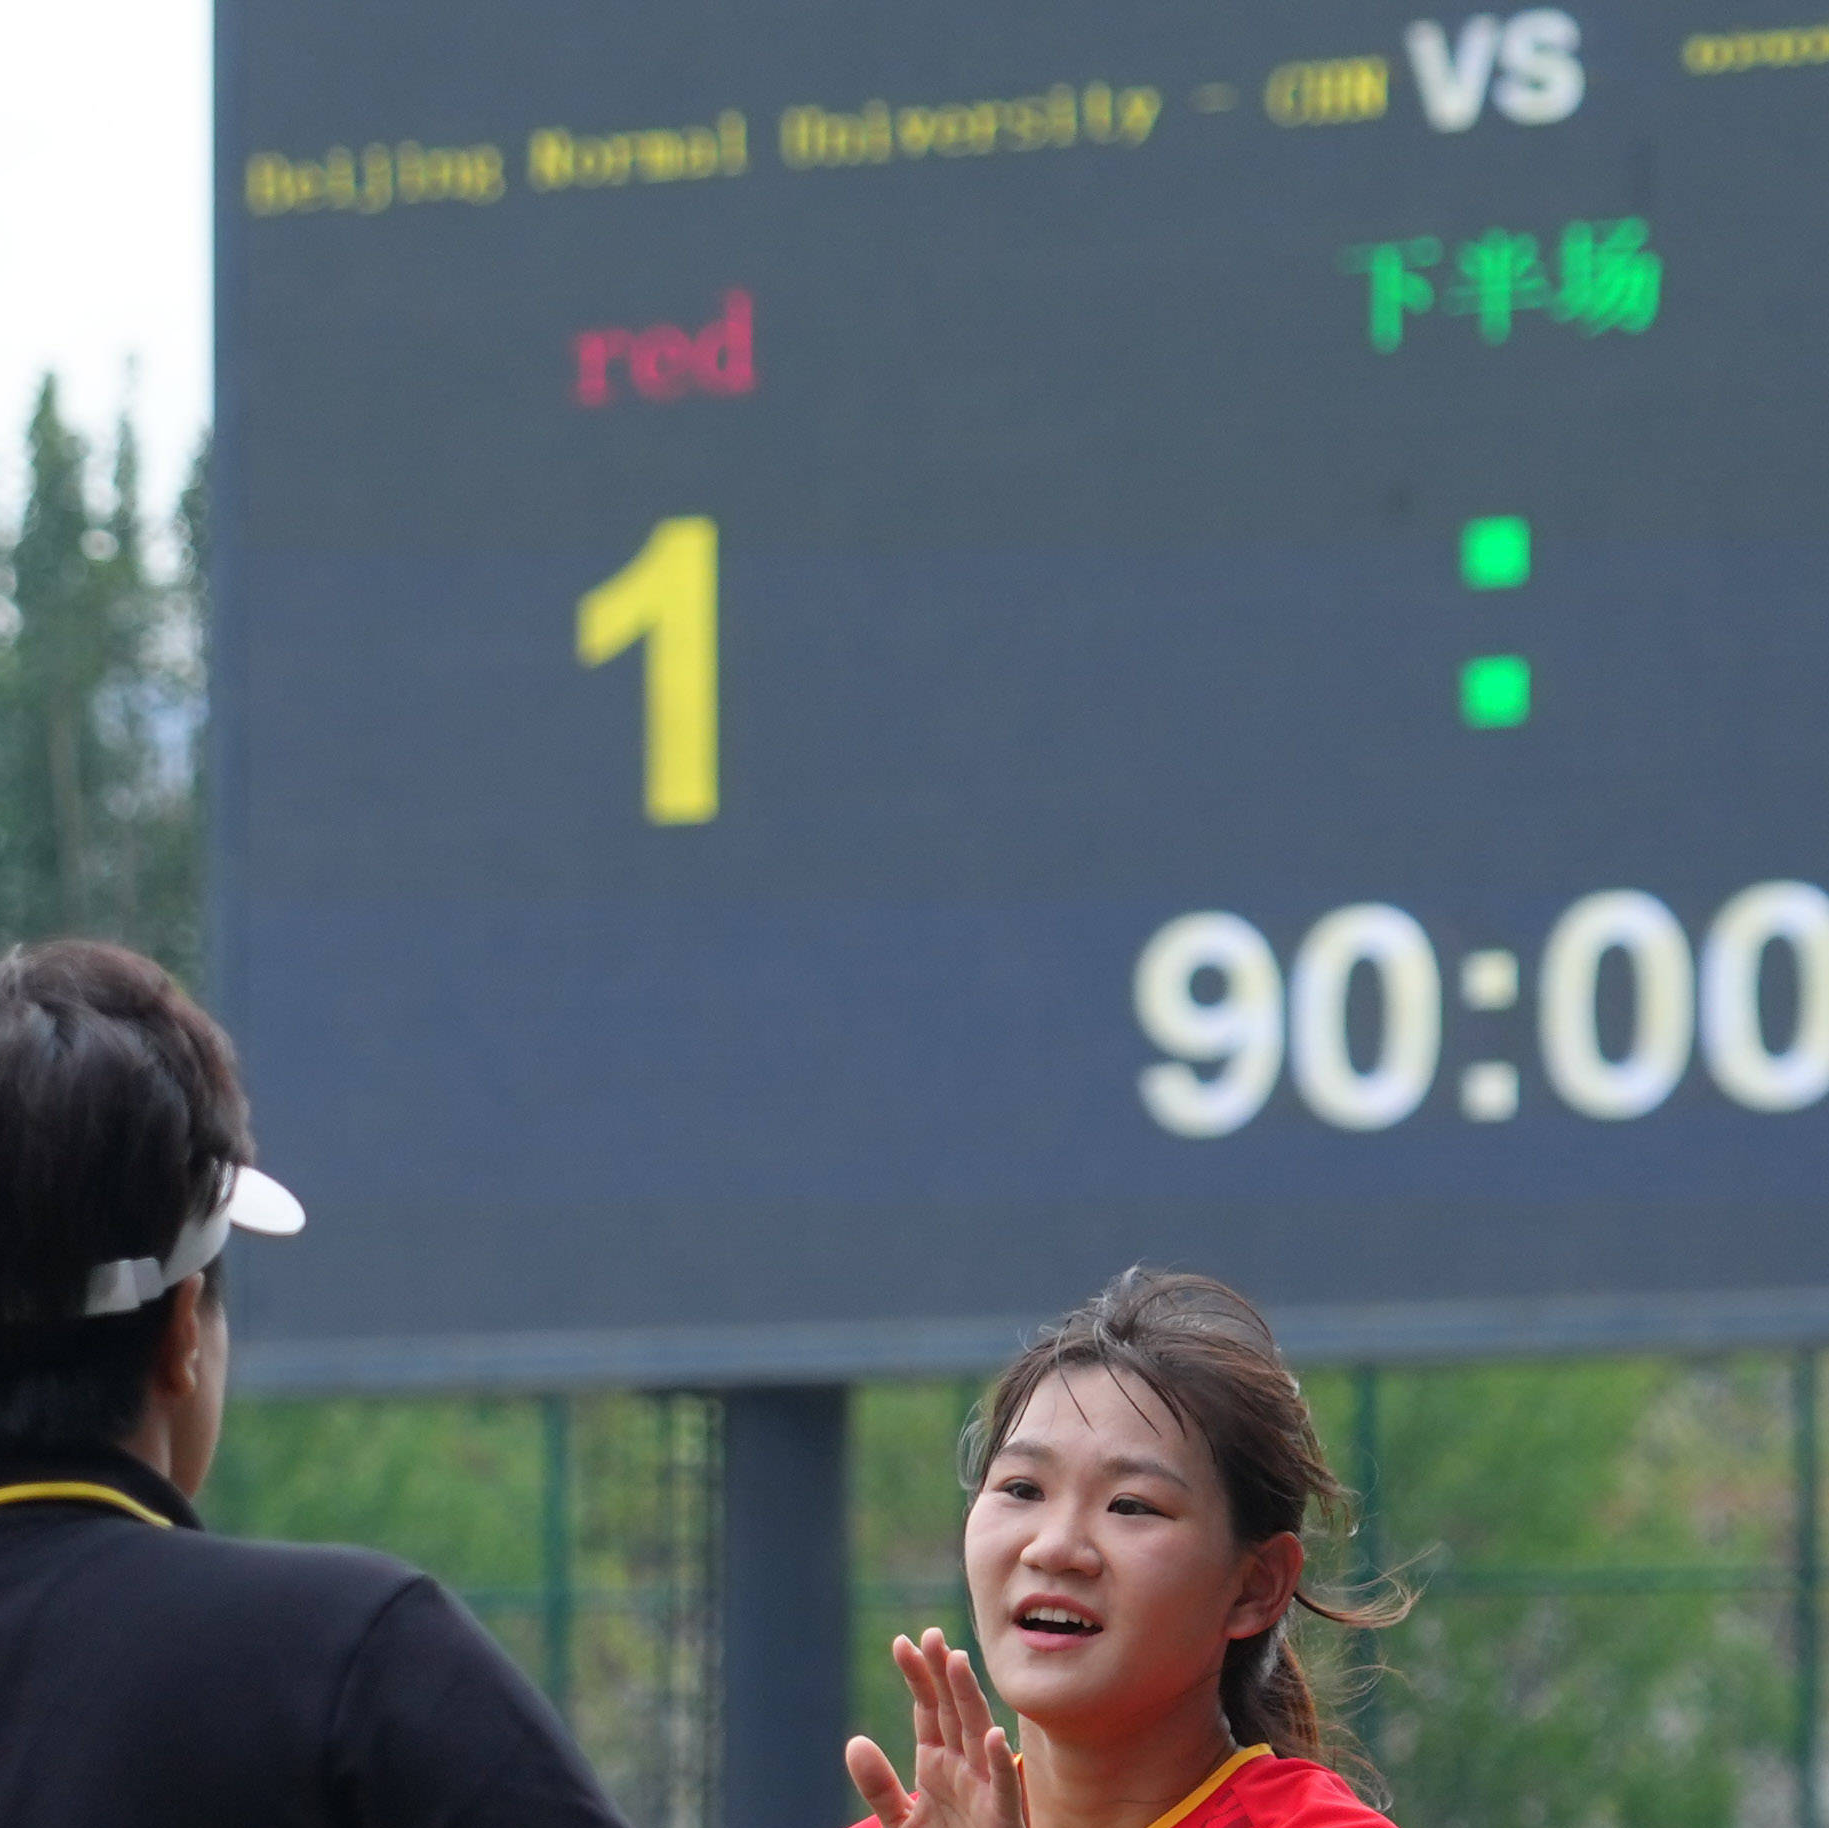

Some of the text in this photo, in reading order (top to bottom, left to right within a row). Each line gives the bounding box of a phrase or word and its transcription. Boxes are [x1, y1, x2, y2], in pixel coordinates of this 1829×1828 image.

[1408, 10, 1584, 130] VS
[244, 144, 506, 214] Beijing
[527, 110, 748, 190] Normal
[780, 84, 1162, 165] University
[572, 288, 756, 406] red
[1350, 216, 1666, 354] 下半场
[578, 516, 718, 823] 1
